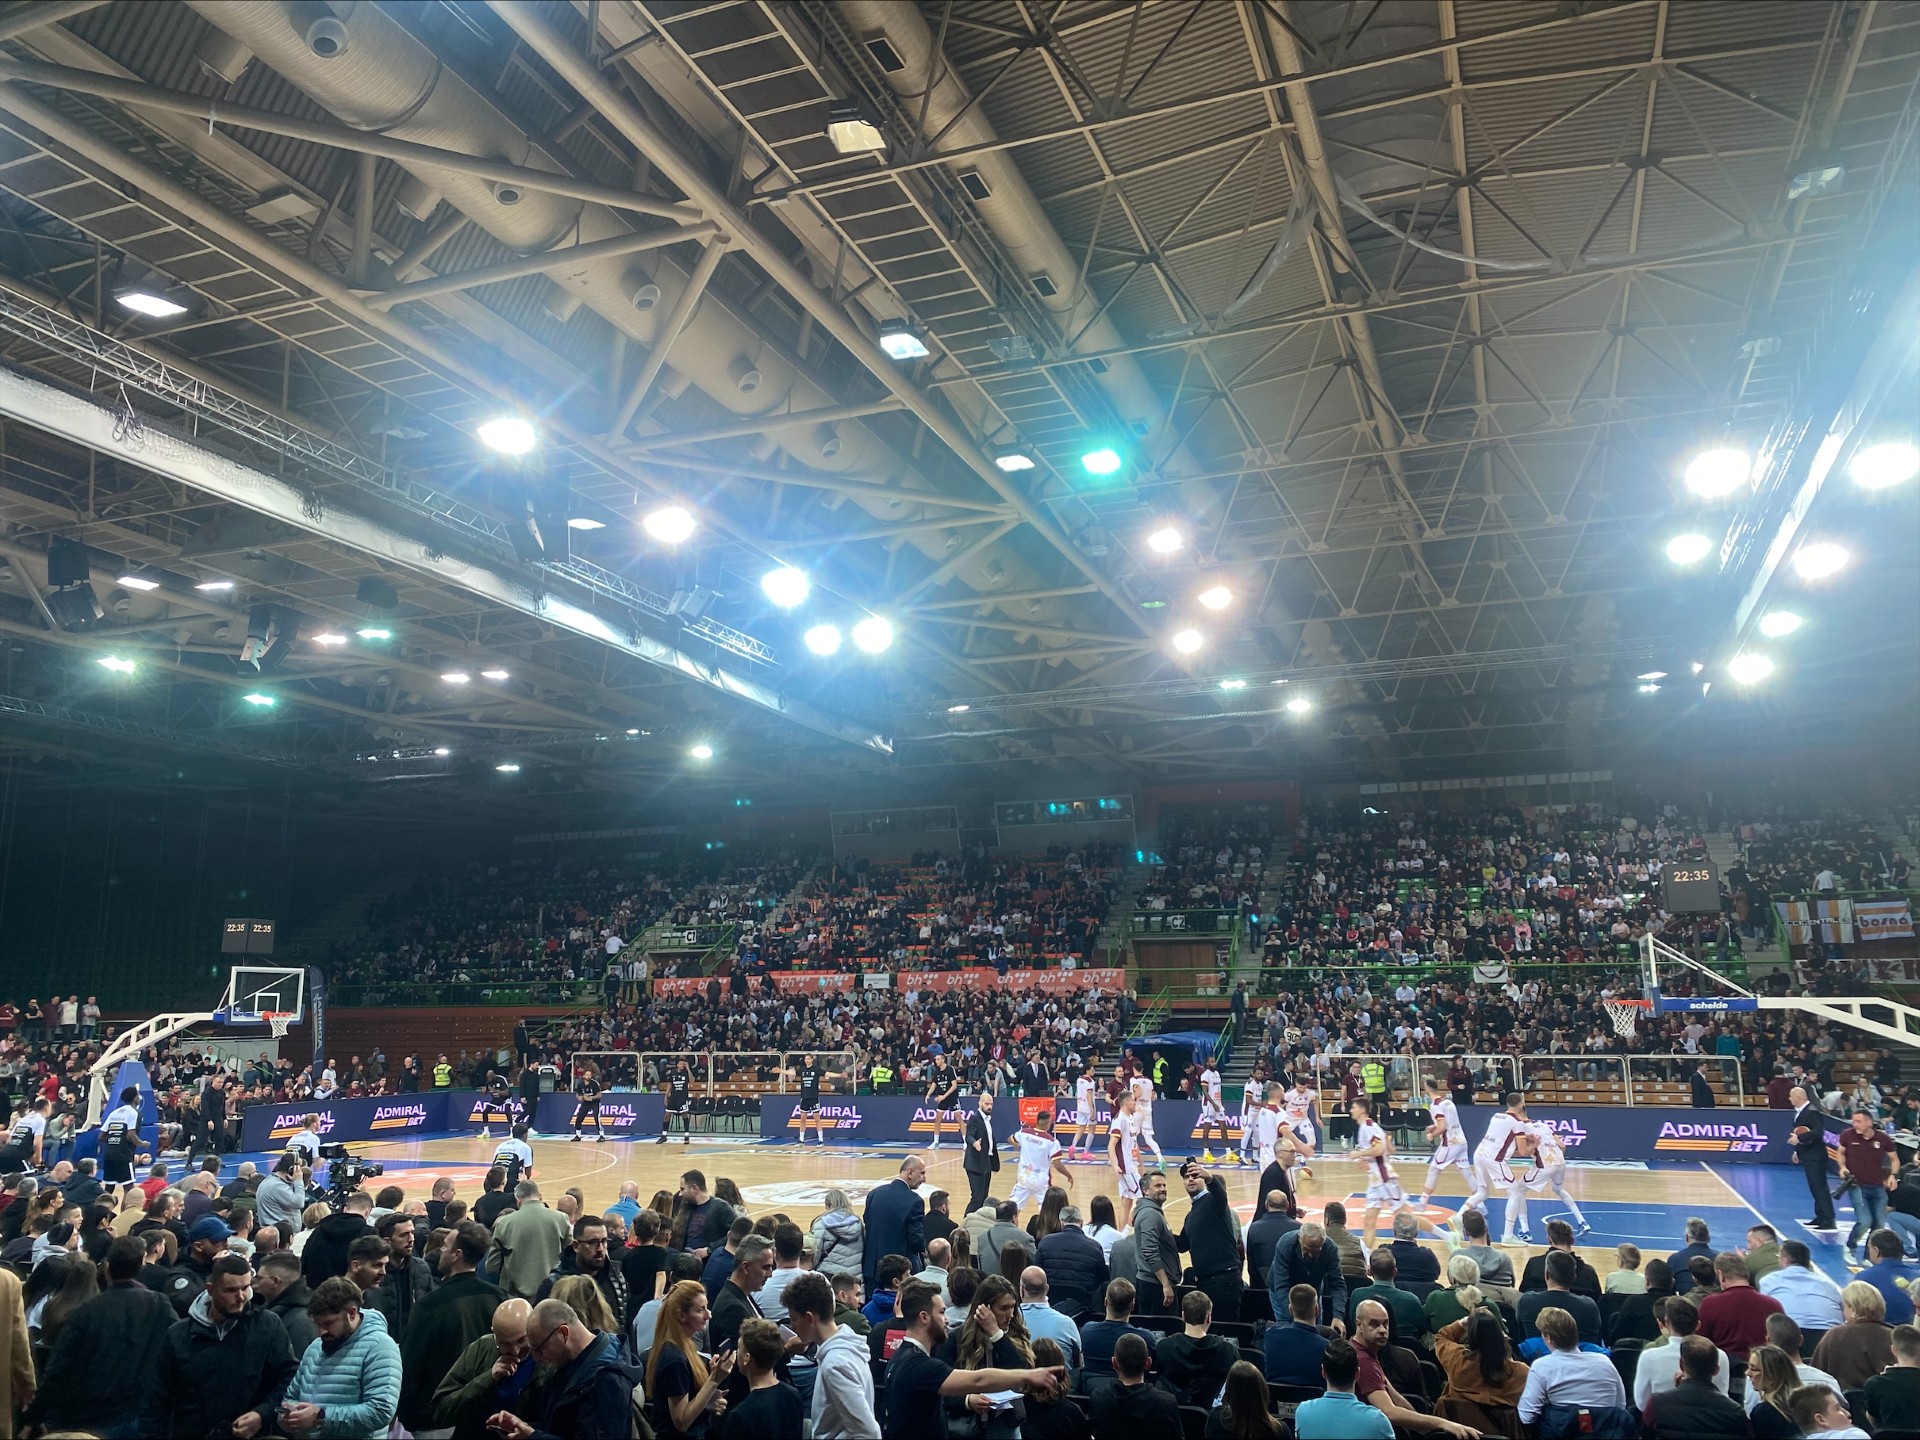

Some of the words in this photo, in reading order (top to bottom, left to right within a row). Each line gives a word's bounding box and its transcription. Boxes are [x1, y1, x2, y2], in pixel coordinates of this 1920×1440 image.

[1673, 870, 1710, 882] 22:35
[226, 924, 246, 932] 22:35
[253, 924, 272, 933] 22:35
[1171, 916, 1185, 929] C2
[686, 931, 696, 942] C1
[906, 973, 922, 985] bh
[946, 973, 963, 985] bh
[1039, 971, 1056, 983] bh
[1082, 970, 1100, 983] bh
[374, 1104, 427, 1120] ADMIRAL
[472, 1100, 525, 1113] AIRA
[573, 1103, 637, 1117] AMIRAL
[791, 1104, 862, 1119] AMIRAL
[273, 1110, 336, 1129] ADMAL
[912, 1107, 975, 1121] ADMIRA
[1056, 1108, 1112, 1123] ADIR
[407, 1116, 426, 1126] BET
[613, 1117, 637, 1127] BET
[836, 1119, 862, 1129] BET
[1659, 1121, 1769, 1140] ADMIRAL
[1729, 1140, 1769, 1153] BET
